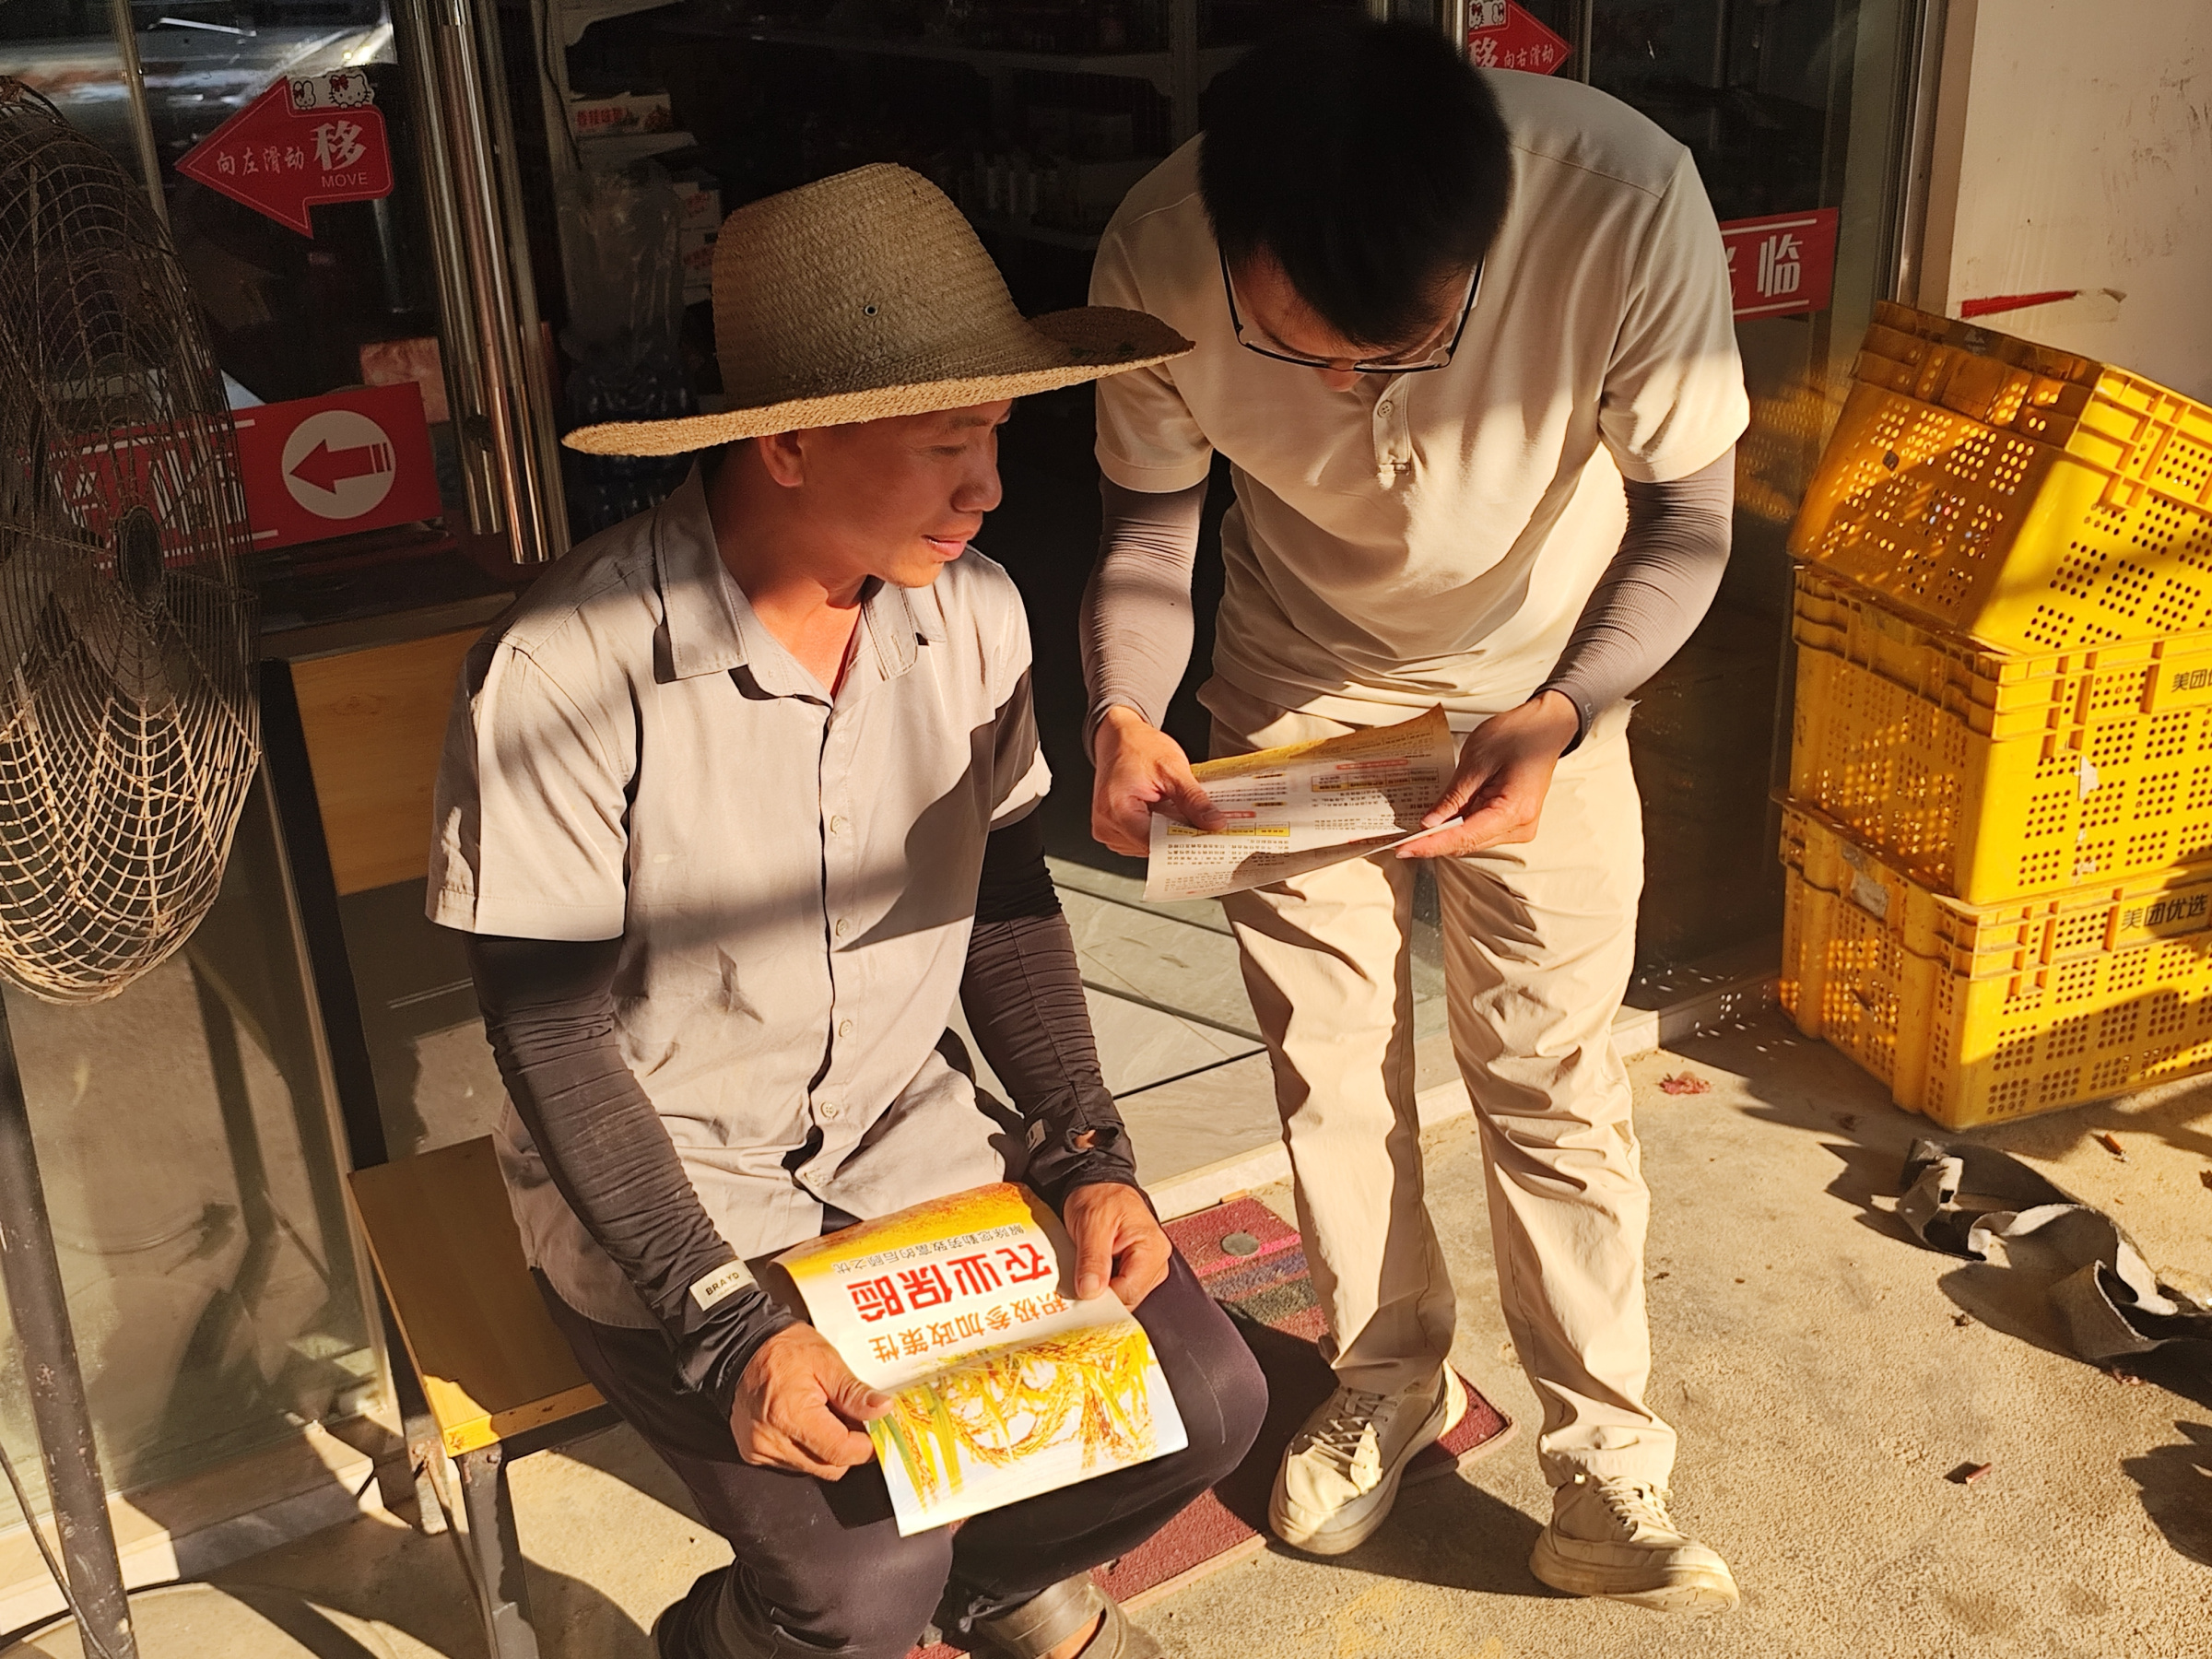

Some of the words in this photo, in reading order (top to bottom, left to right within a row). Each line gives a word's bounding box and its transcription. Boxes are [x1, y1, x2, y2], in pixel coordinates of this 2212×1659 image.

[1504, 43, 1555, 69] 向右滑动
[216, 145, 306, 177] 向左滑动
[310, 120, 367, 171] 移
[321, 171, 369, 189] MOVE
[1725, 233, 1804, 299] 临
[2171, 668, 2212, 693] 美团
[2120, 892, 2208, 933] 美团优选
[832, 1224, 1026, 1275] 解除您勤劳致富的后顾之忧
[846, 1242, 1053, 1323] 农业保险
[869, 1290, 1069, 1364] 积极参加政策性
